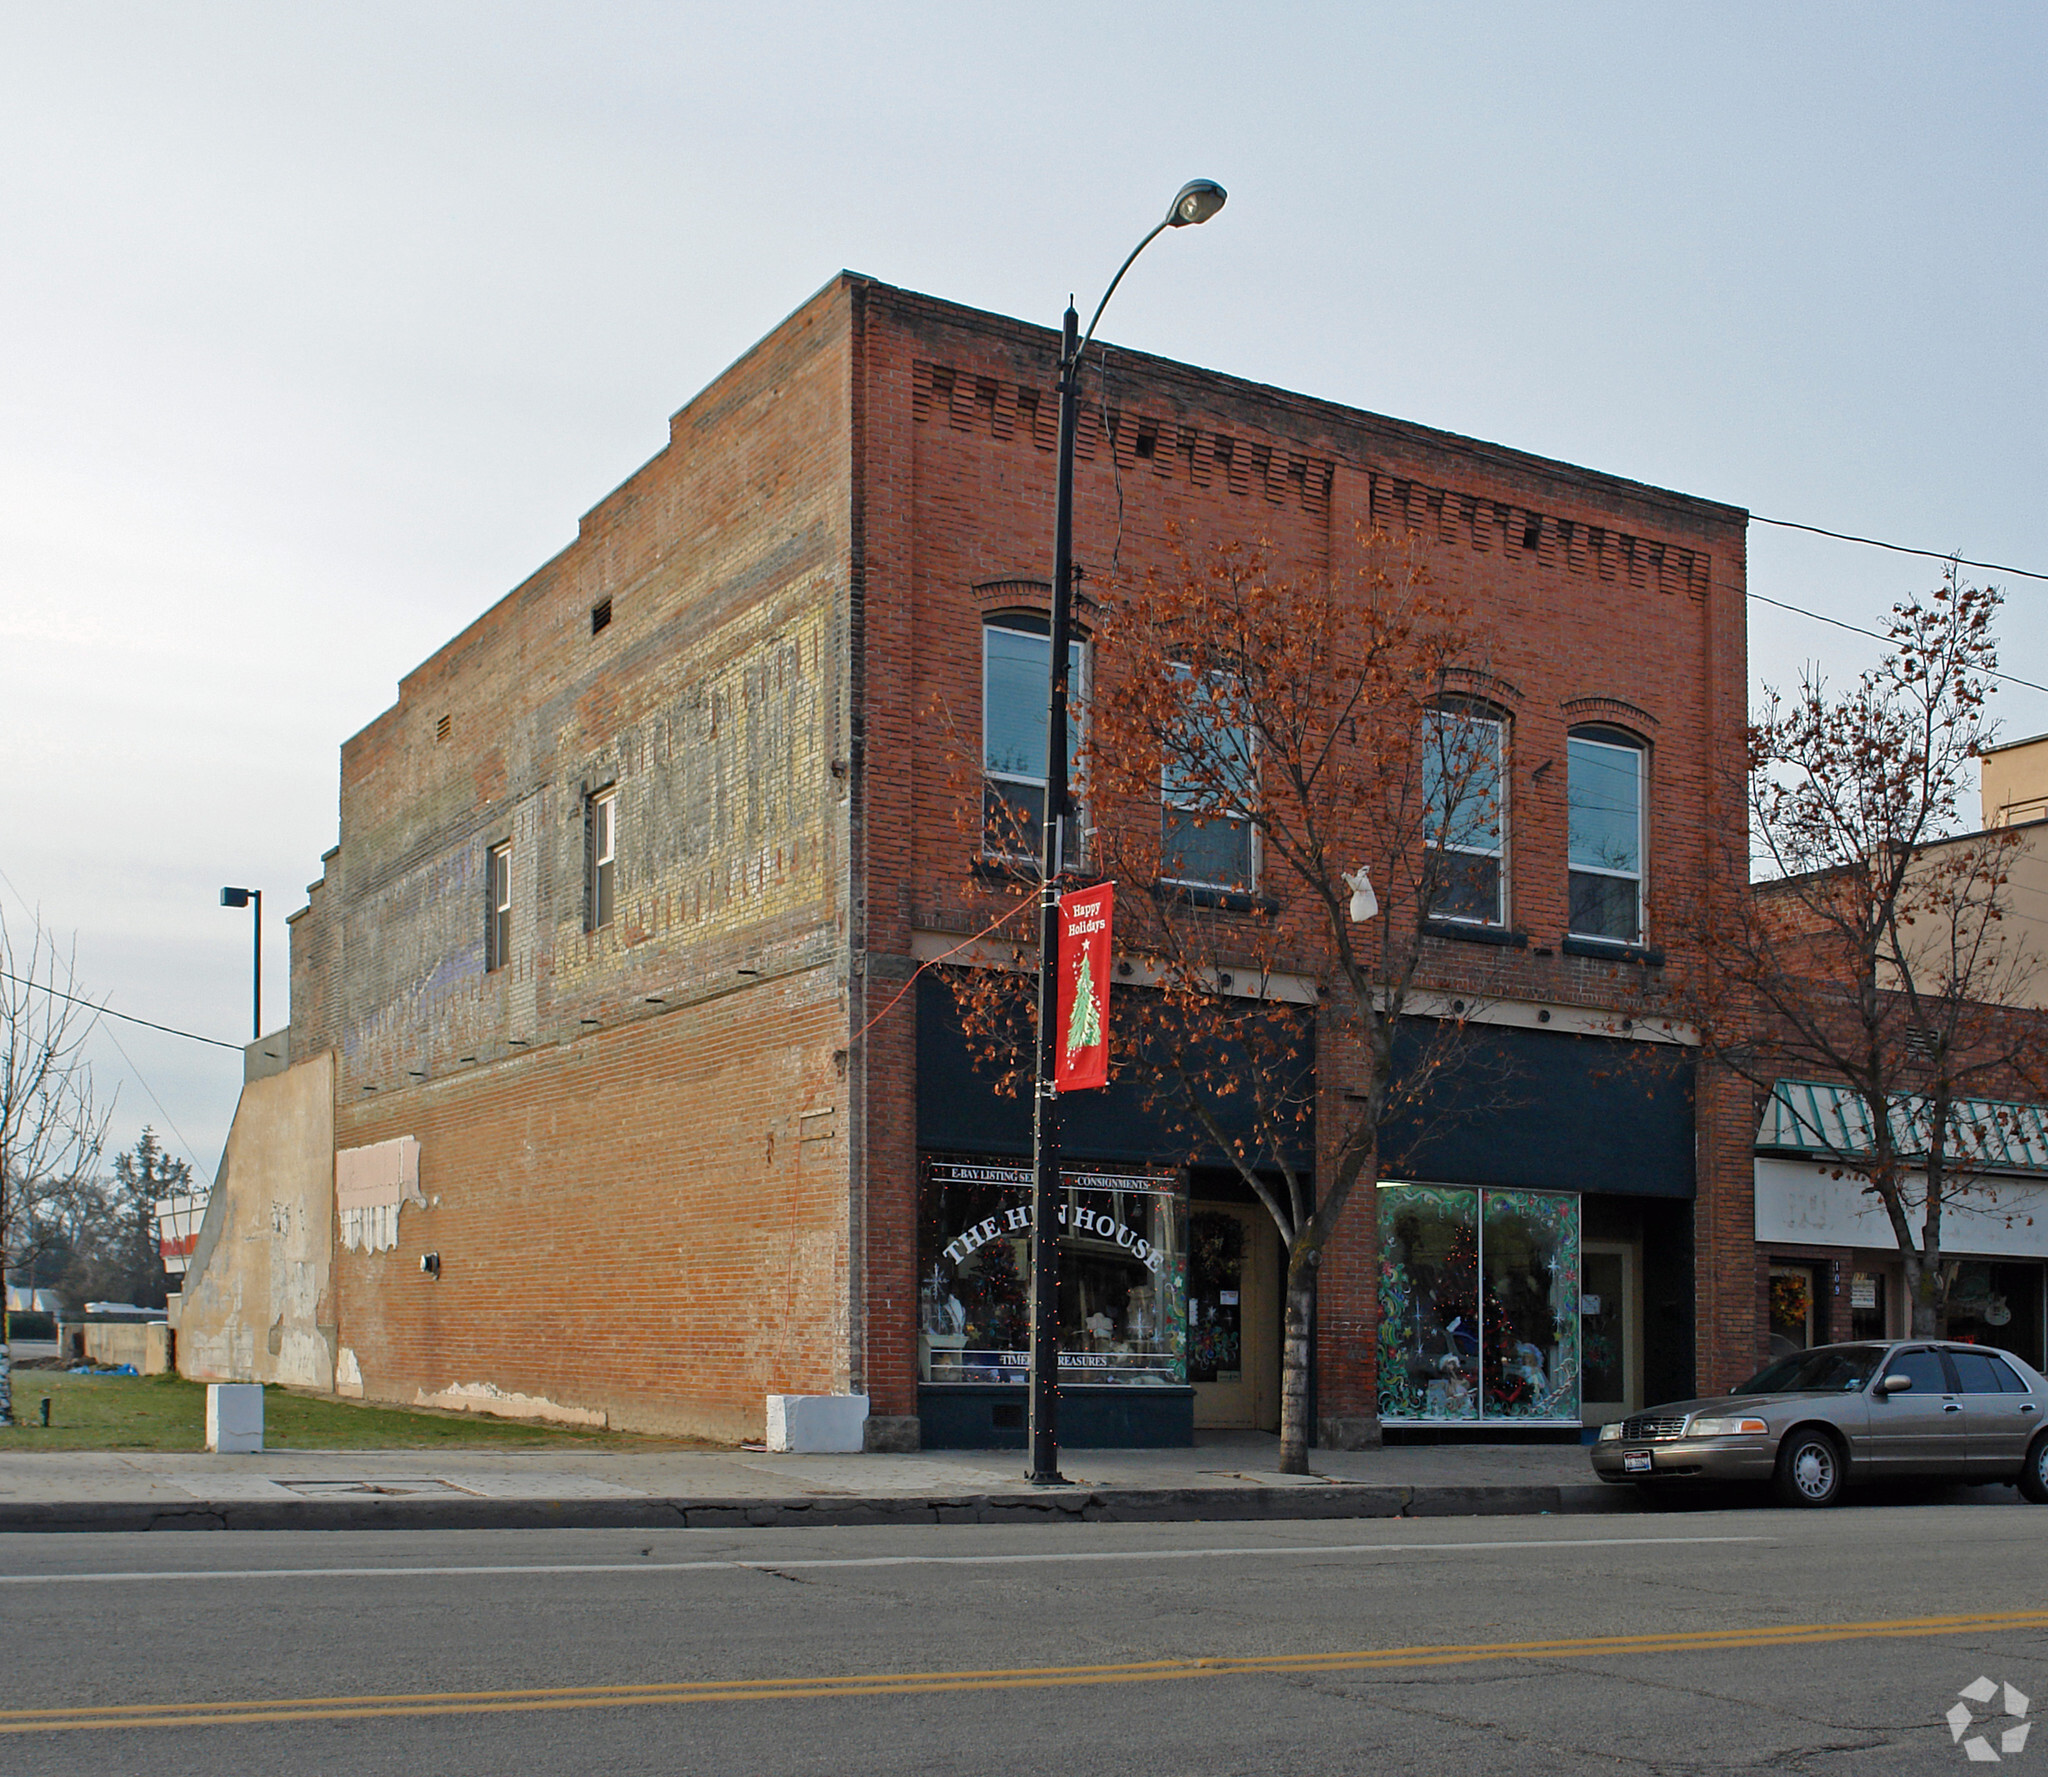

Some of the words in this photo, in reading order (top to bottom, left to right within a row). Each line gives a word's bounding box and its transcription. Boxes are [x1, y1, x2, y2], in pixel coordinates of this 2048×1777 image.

[1072, 901, 1101, 918] Happy
[1068, 919, 1106, 937] Holidays
[951, 1168, 980, 1180] E-BAY
[980, 1170, 1019, 1182] LISTING
[1077, 1175, 1150, 1190] CONSIGNMENTS
[942, 1216, 1002, 1266] THE
[1072, 1206, 1165, 1274] HOUSE
[1057, 1355, 1107, 1367] REASURES
